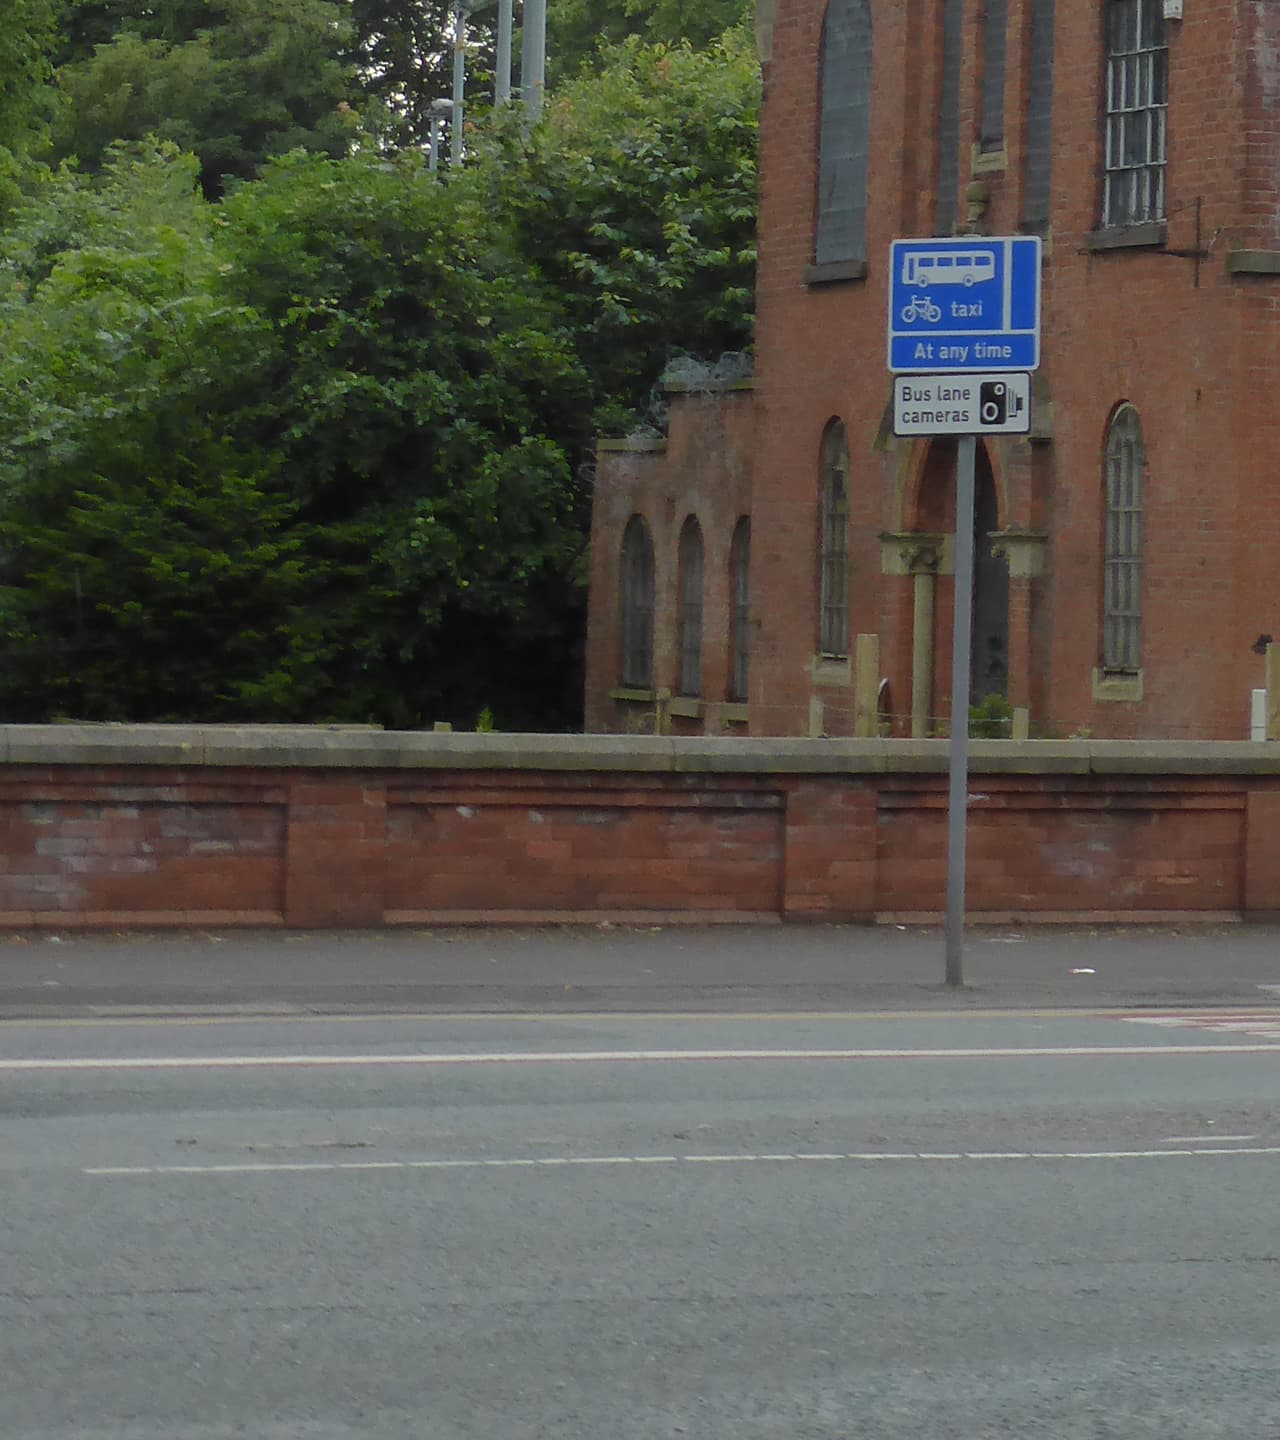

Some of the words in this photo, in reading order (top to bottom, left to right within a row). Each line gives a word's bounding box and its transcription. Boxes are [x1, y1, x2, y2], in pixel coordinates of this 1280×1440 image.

[951, 300, 983, 318] taxi
[914, 343, 933, 360] At
[939, 345, 969, 363] any
[975, 342, 1012, 359] time
[901, 387, 931, 402] Bus
[937, 385, 971, 401] lane
[902, 410, 969, 424] cameras
